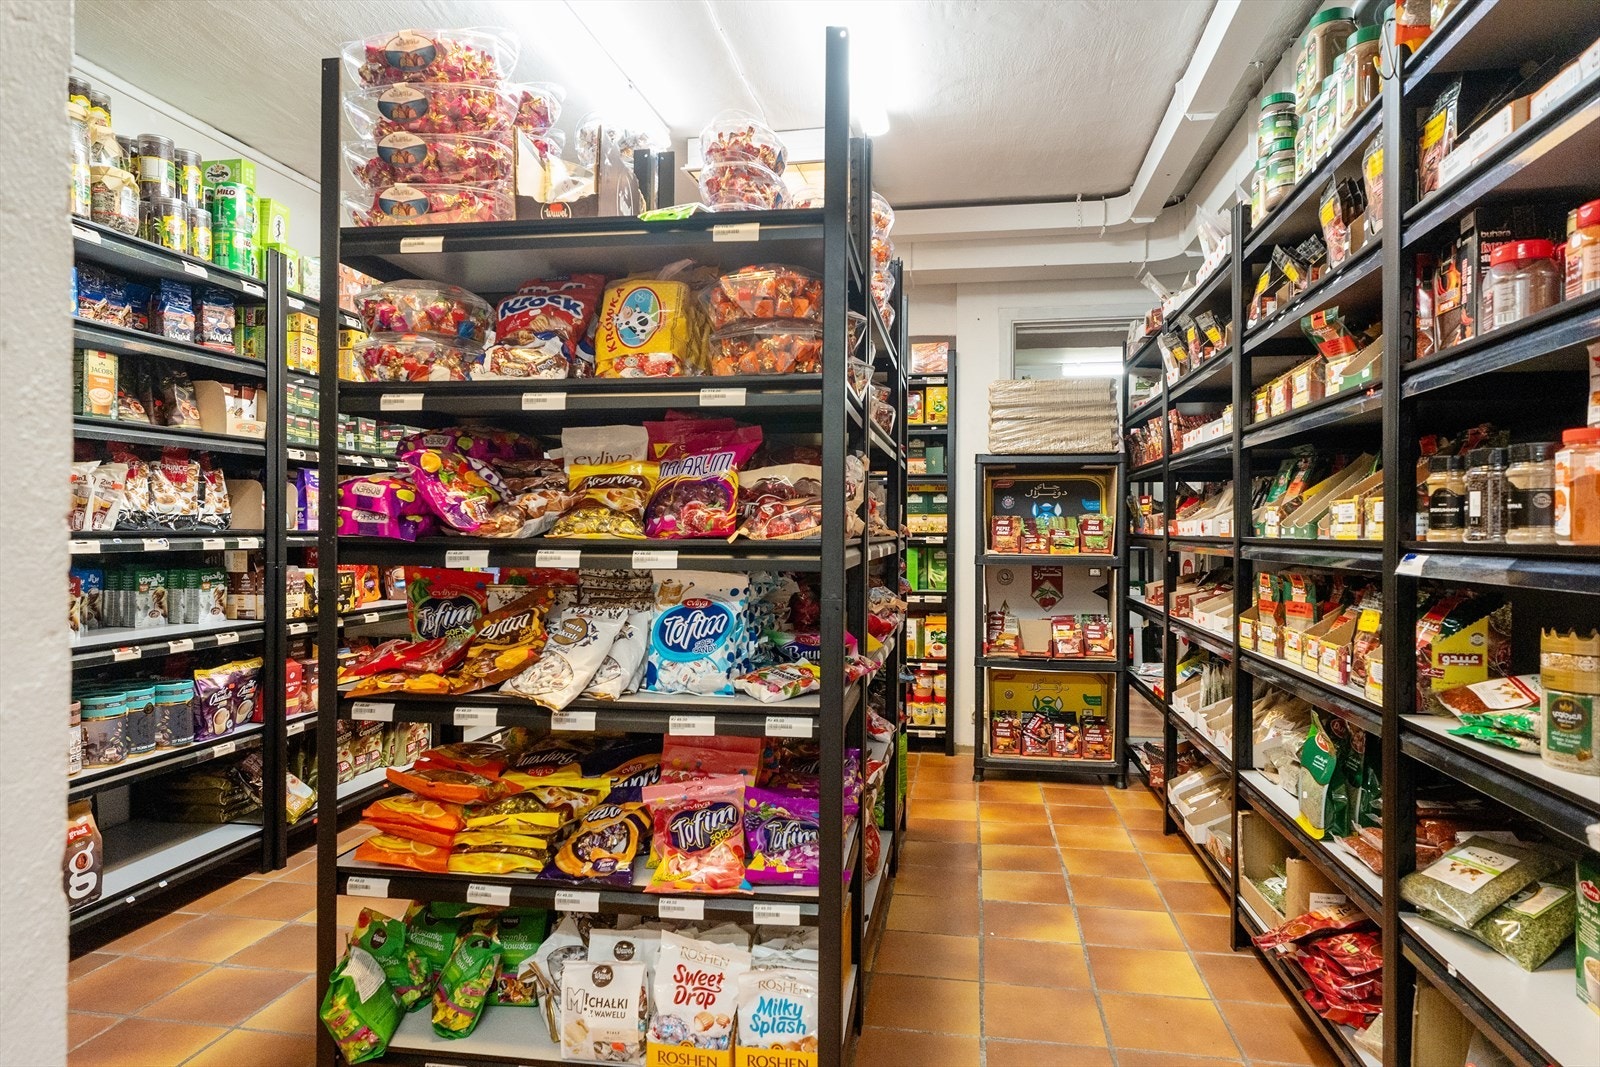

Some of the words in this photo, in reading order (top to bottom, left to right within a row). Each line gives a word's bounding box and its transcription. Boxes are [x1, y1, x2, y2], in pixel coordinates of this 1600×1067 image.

[216, 187, 235, 197] MILO
[1480, 230, 1511, 239] buhara
[499, 294, 583, 319] Krock
[605, 287, 625, 353] KRÓWKA
[91, 366, 113, 376] JACOBS
[161, 464, 188, 472] PRINCE
[355, 484, 382, 496] ROSHEN
[421, 602, 473, 638] Tofim
[444, 629, 464, 637] SOFT
[664, 611, 727, 649] Tofim
[692, 643, 718, 655] CANDY
[68, 826, 89, 840] grand
[670, 804, 738, 850] Tofim
[765, 821, 819, 853] Tofim
[1582, 884, 1600, 901] Durra
[680, 946, 730, 967] ROSHEN
[673, 964, 725, 989] Sweet
[758, 980, 809, 995] ROSHEN
[673, 985, 715, 1010] Drop
[595, 1011, 626, 1019] WAWELU
[756, 996, 804, 1021] Milky
[749, 1014, 807, 1037] Splash
[657, 1050, 718, 1067] ROSHEN
[747, 1054, 809, 1067] ROSHEN
